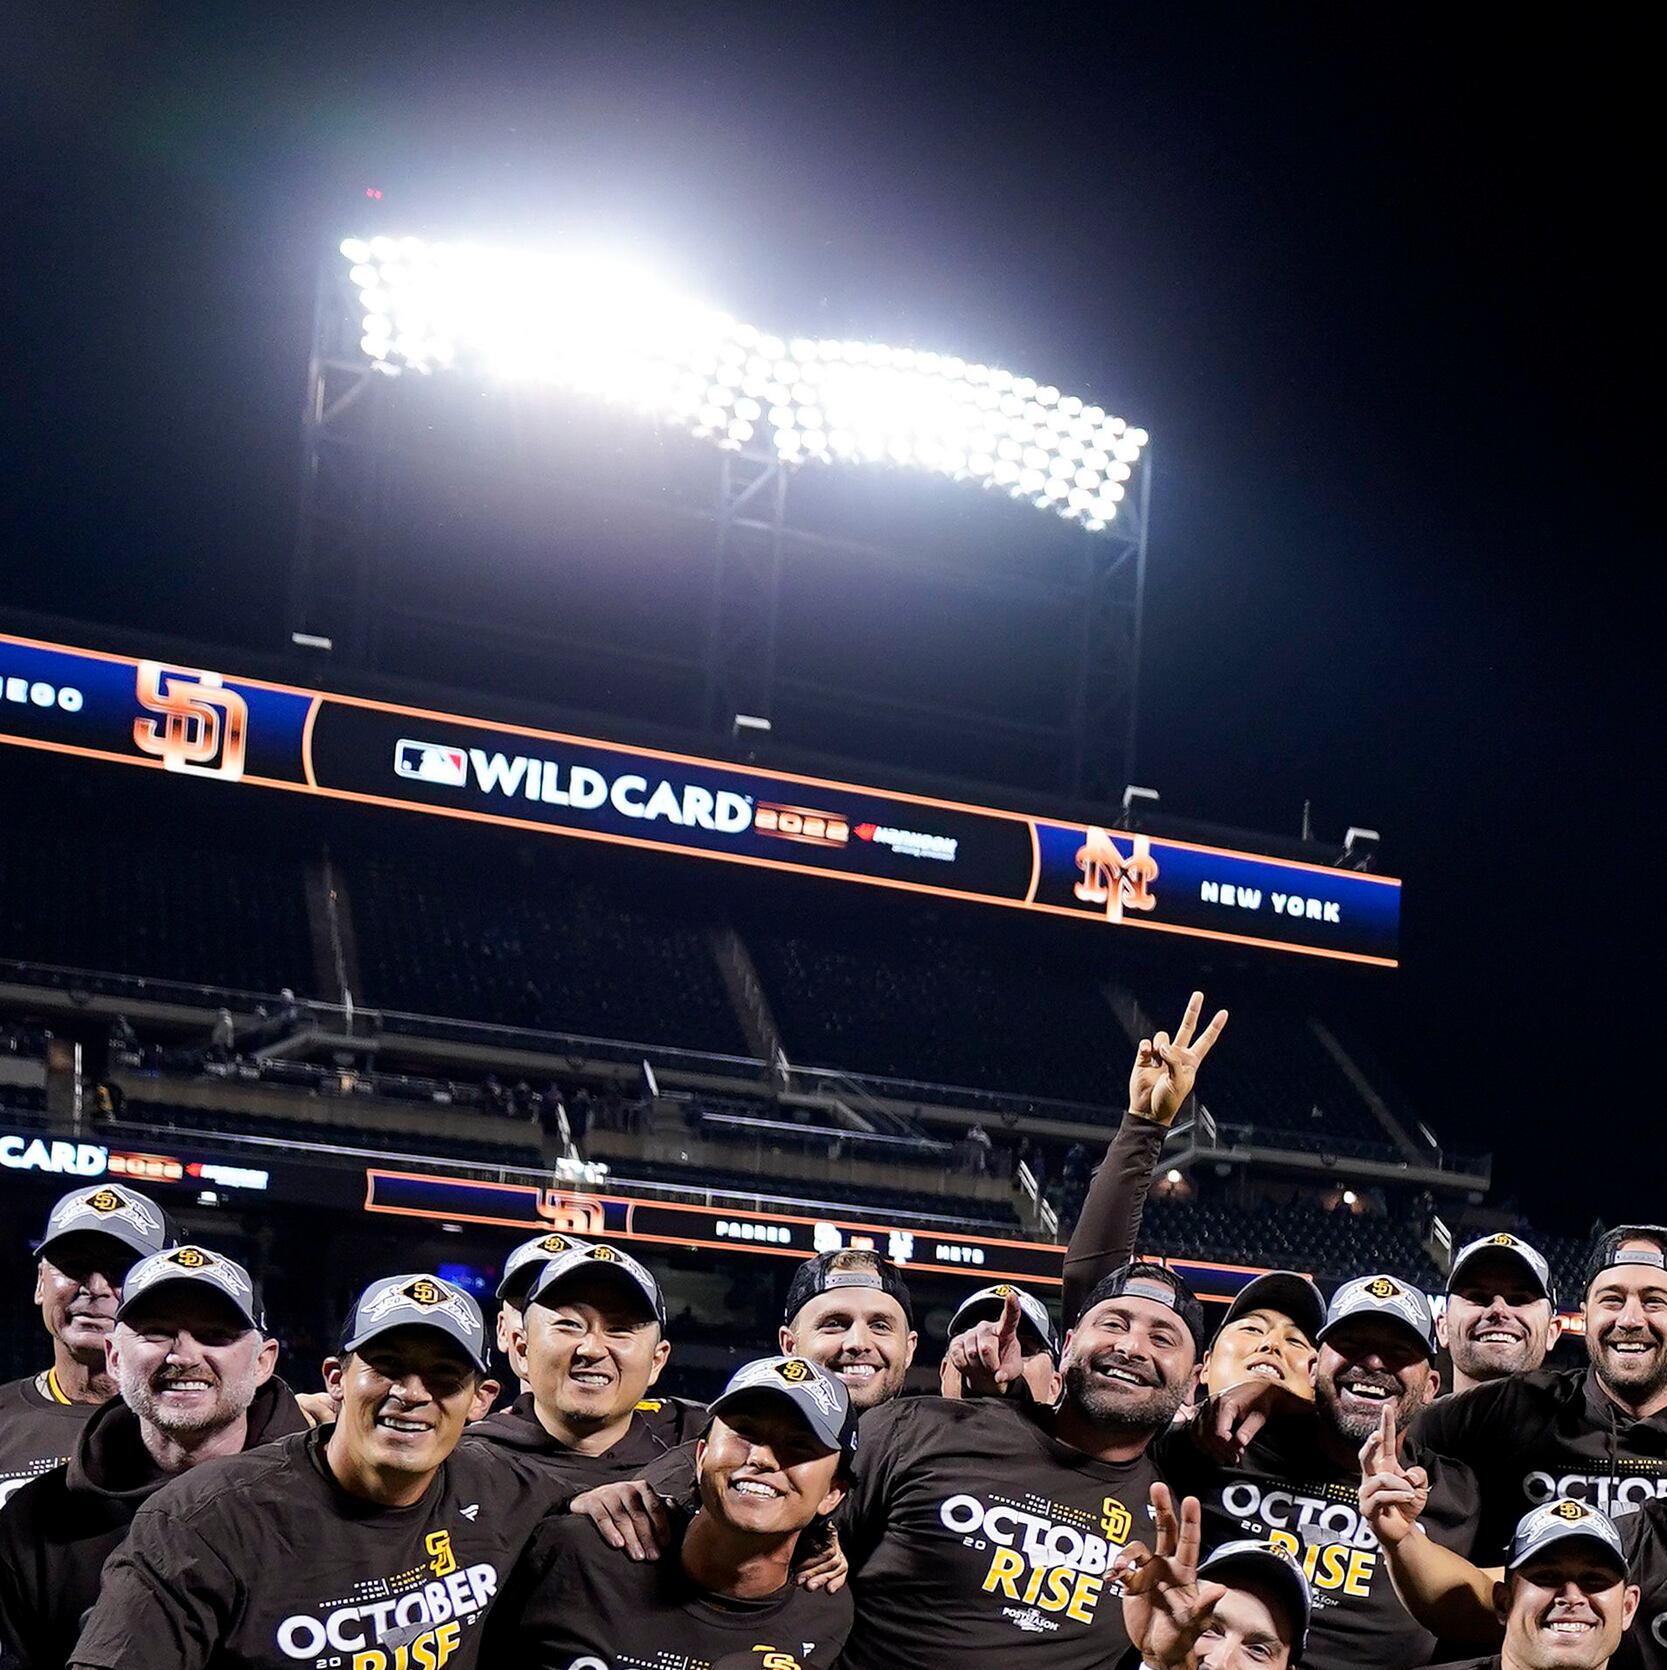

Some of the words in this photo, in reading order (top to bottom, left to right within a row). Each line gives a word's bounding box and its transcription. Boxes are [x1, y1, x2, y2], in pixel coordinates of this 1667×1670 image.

[0, 676, 84, 712] EGO
[469, 746, 606, 811] WILD
[609, 774, 752, 833] CARD
[755, 808, 849, 843] 2022
[1200, 880, 1262, 910] NEW
[1270, 891, 1341, 924] YORK
[0, 1135, 105, 1177] CARD
[1101, 1497, 1132, 1545] SD
[425, 1530, 457, 1580] SD
[962, 1536, 985, 1551] 20
[980, 1545, 1106, 1625] RISE
[276, 1562, 499, 1661] OCTOBER
[316, 1656, 342, 1670] 20
